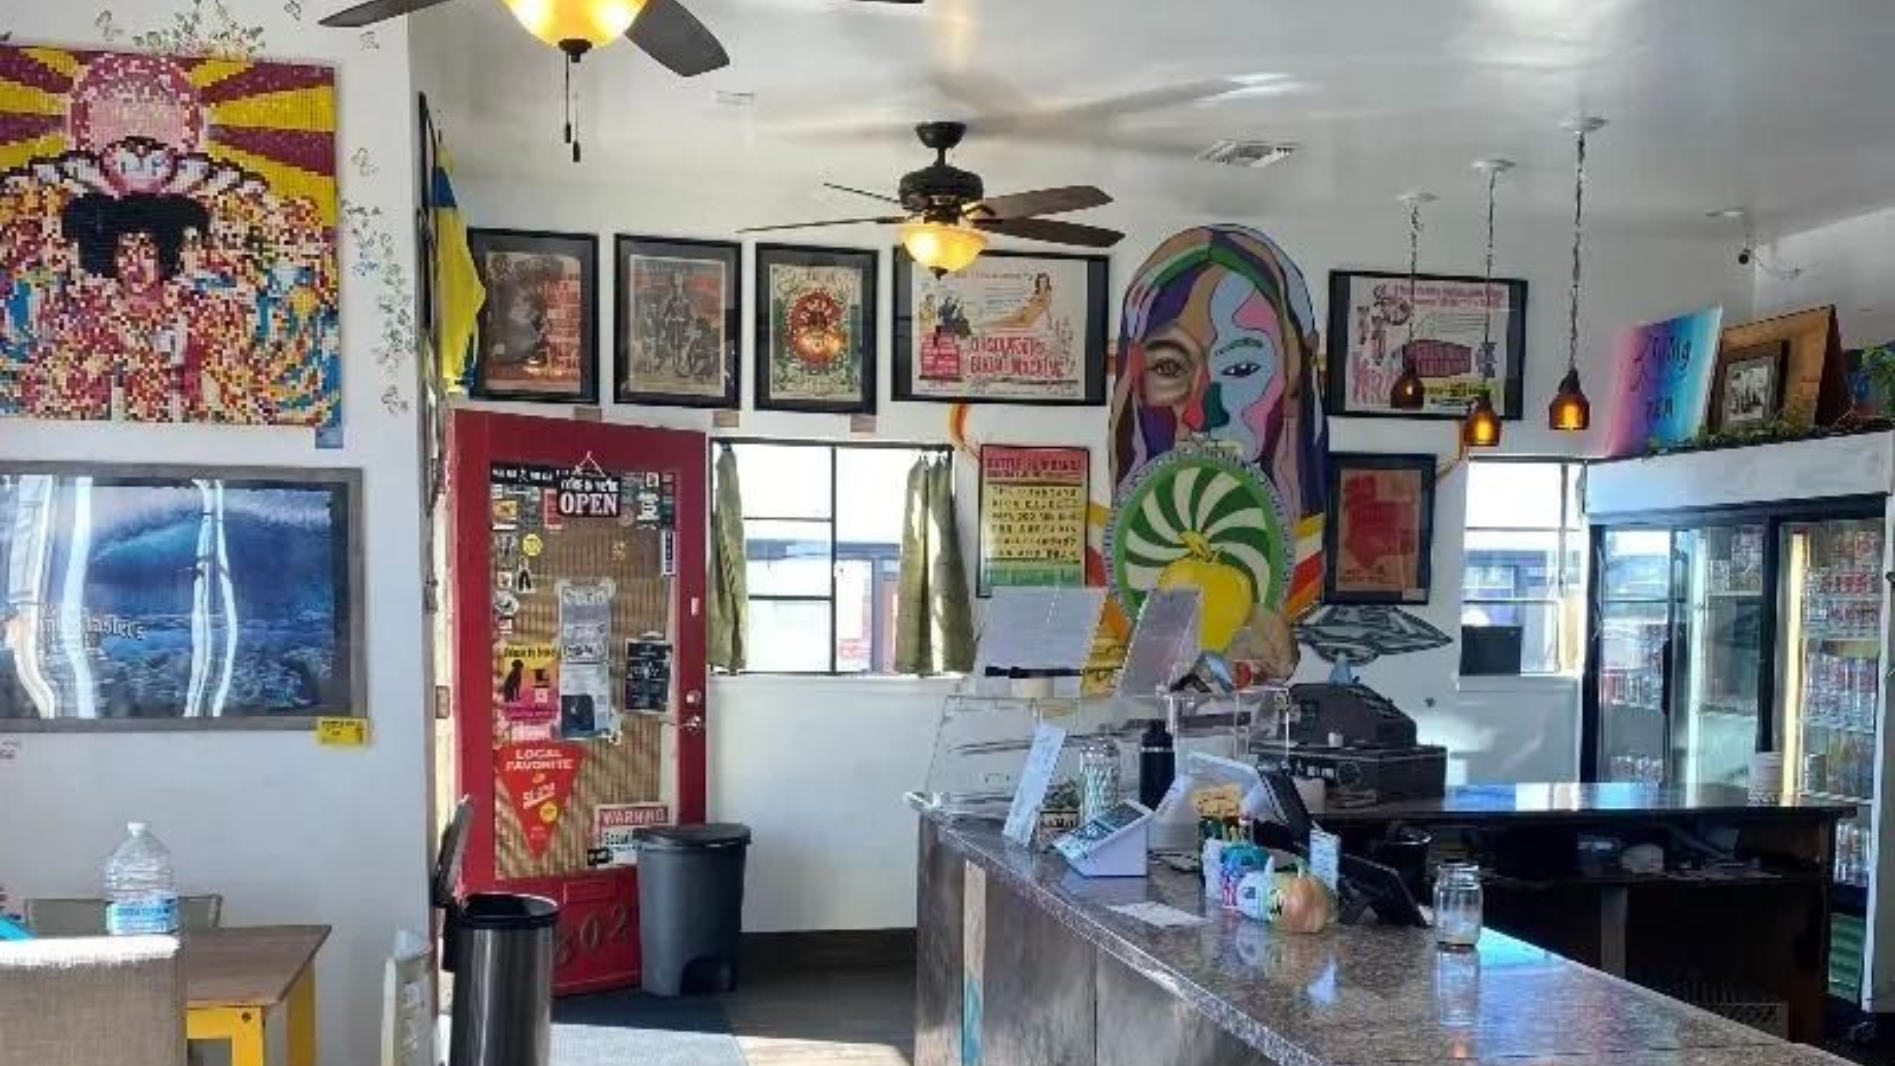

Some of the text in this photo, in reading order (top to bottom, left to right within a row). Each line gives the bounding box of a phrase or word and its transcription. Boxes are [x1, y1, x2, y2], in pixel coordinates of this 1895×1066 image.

[560, 491, 618, 516] OPEN
[515, 748, 563, 760] LOCAL
[505, 758, 574, 772] FAVORITE
[603, 808, 666, 825] WARNING
